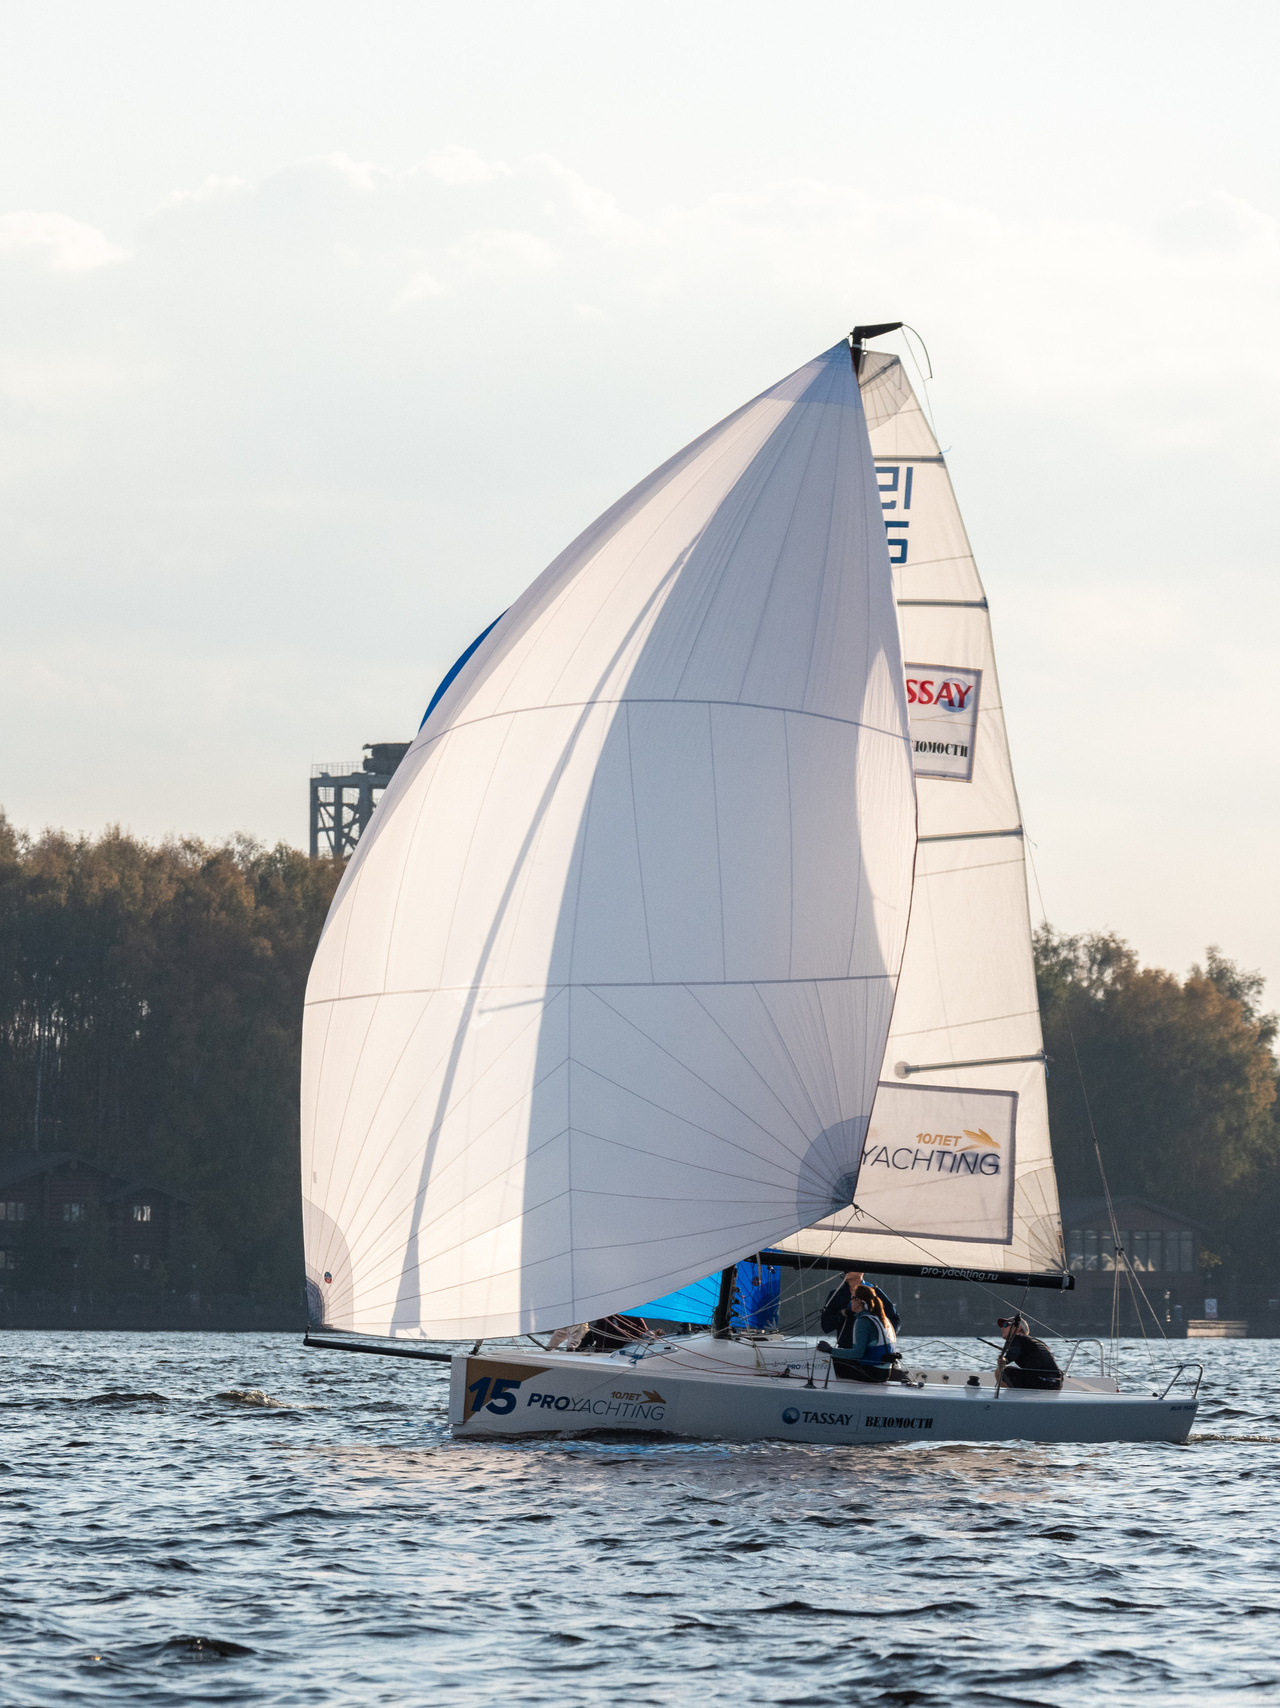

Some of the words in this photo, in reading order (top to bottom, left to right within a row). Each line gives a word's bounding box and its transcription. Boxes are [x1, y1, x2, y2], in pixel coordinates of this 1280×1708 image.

[920, 1266, 999, 1281] pro-yachting.ru
[468, 1376, 522, 1416] 15
[526, 1392, 667, 1421] PROYACHTING
[802, 1411, 853, 1425] TASSAY
[865, 1416, 934, 1429] ВЕДОМОСТИ
